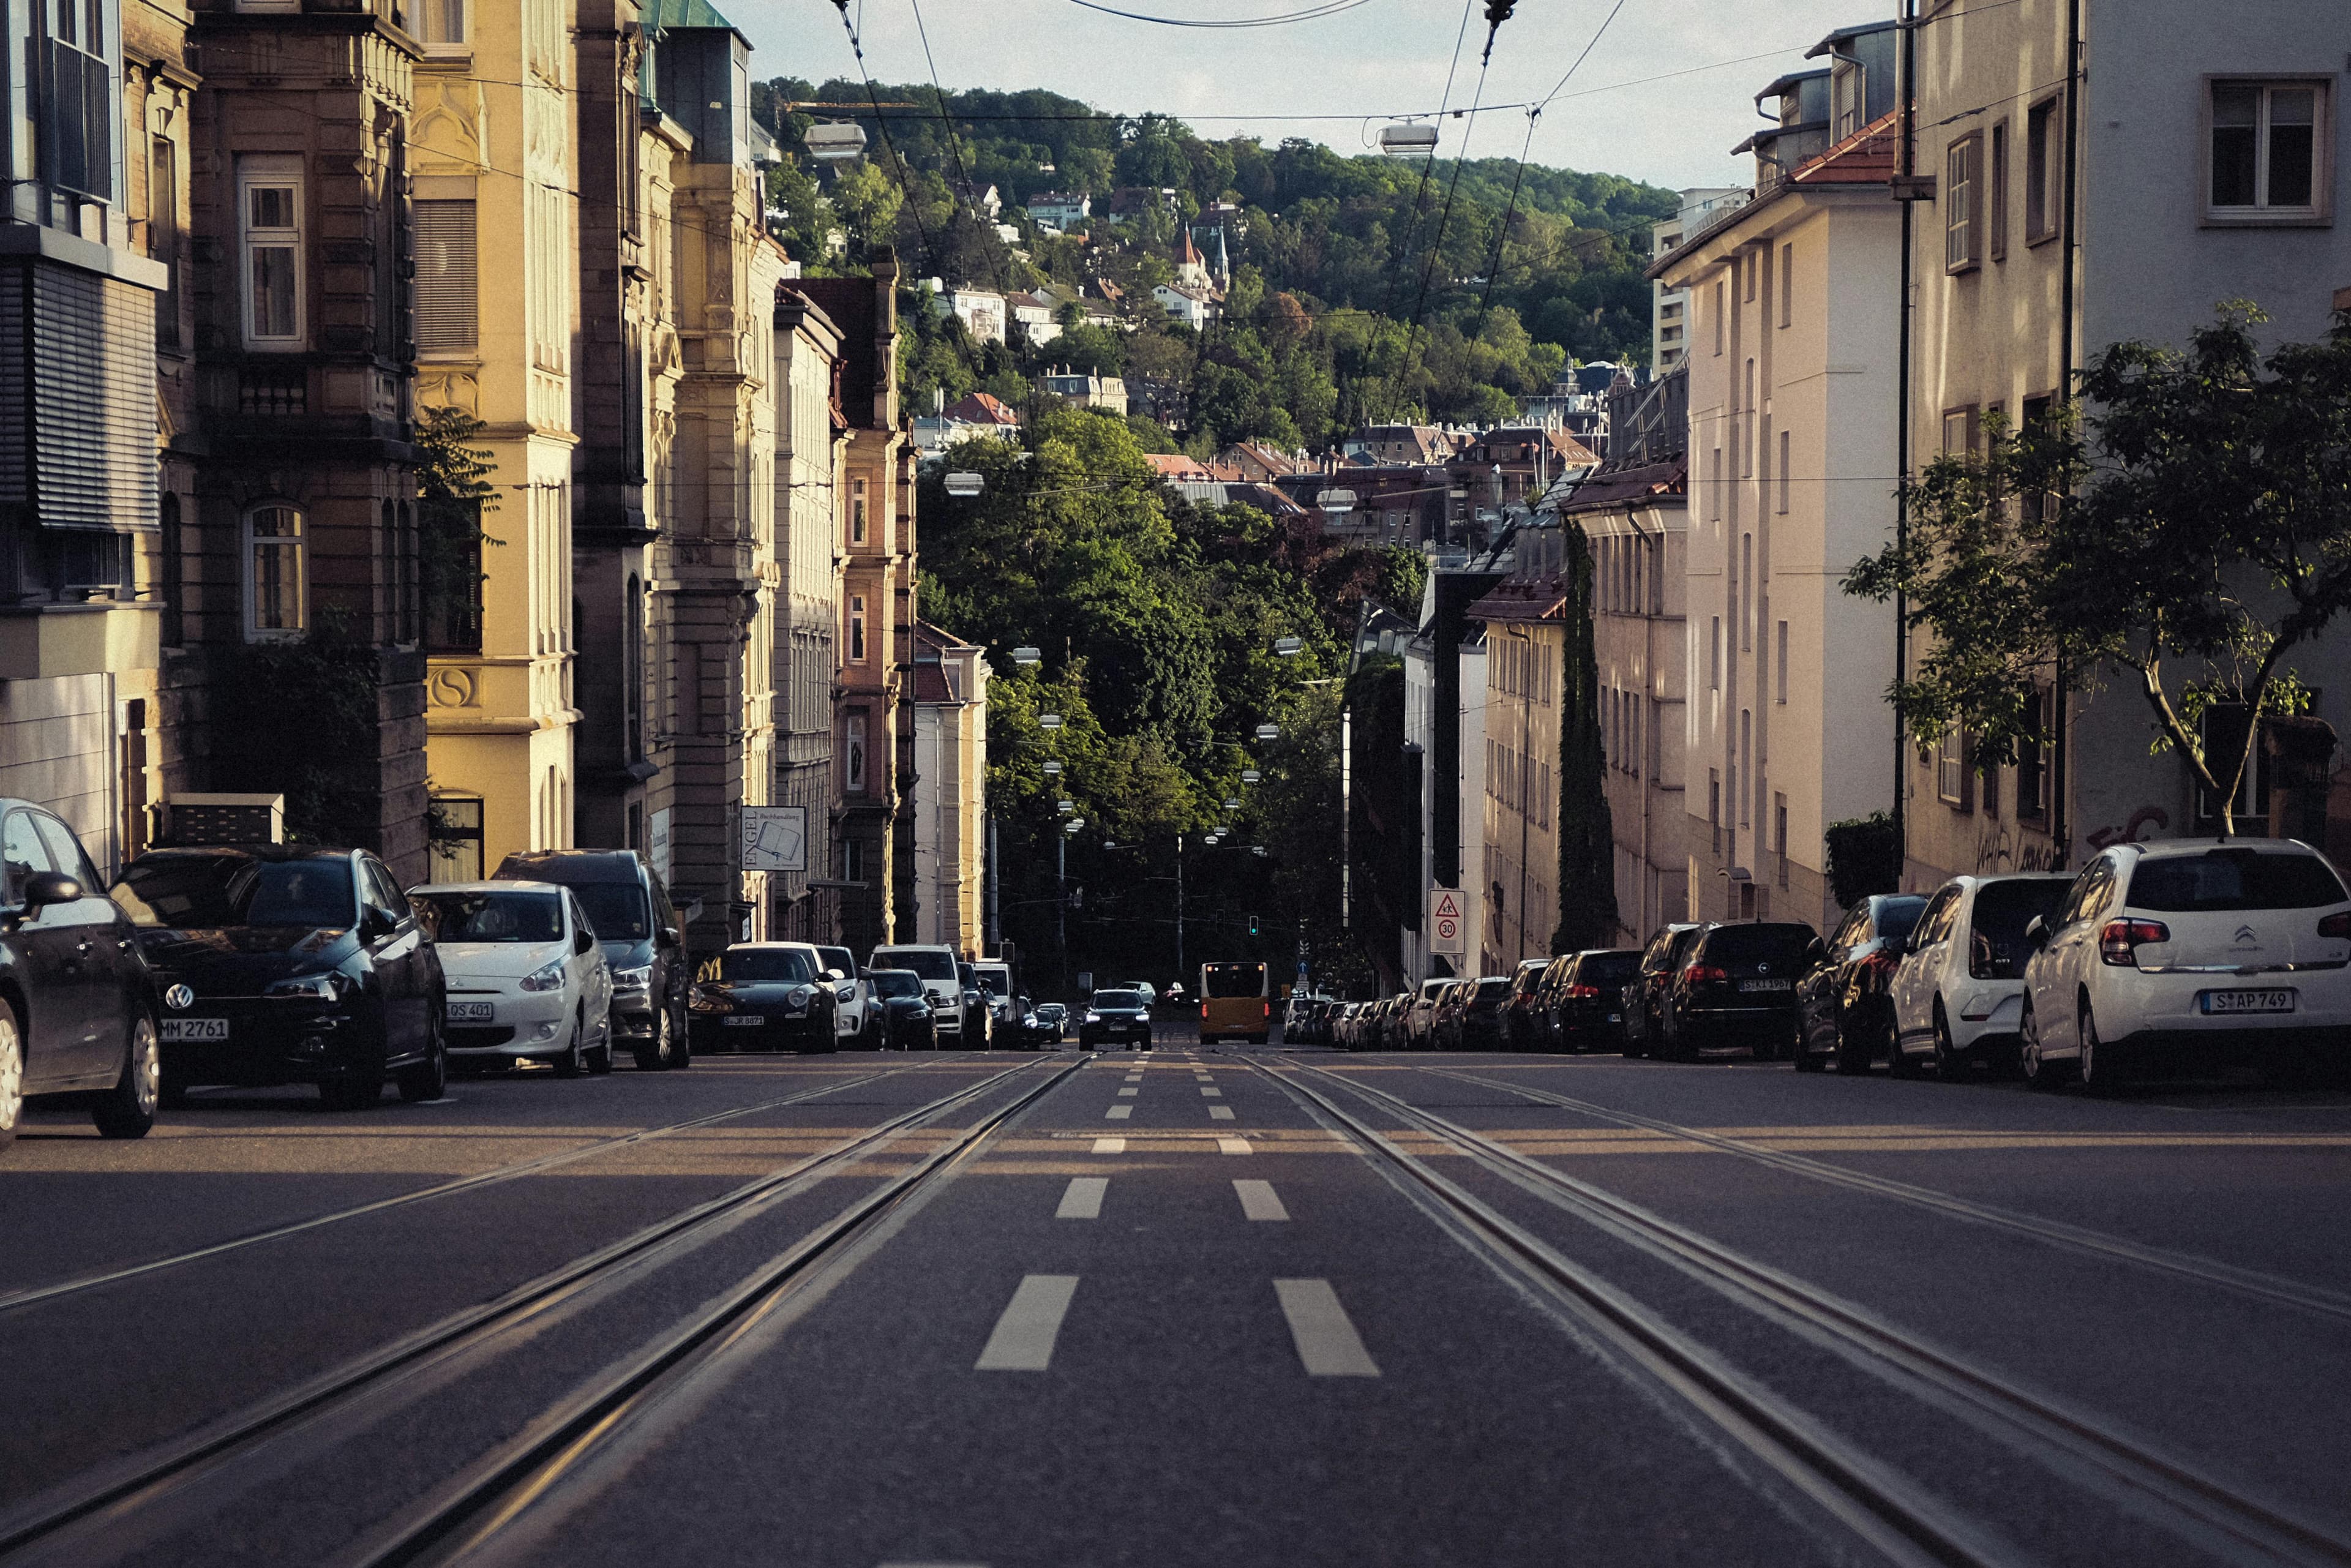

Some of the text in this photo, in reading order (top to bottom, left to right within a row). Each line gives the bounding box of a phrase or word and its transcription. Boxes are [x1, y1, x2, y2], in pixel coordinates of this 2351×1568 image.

[745, 811, 757, 865] ENGEL
[1442, 925, 1452, 933] 30
[1756, 980, 1766, 988] KI
[2217, 992, 2287, 1008] S AP 749
[469, 1004, 490, 1016] 401
[185, 1021, 226, 1037] 2761
